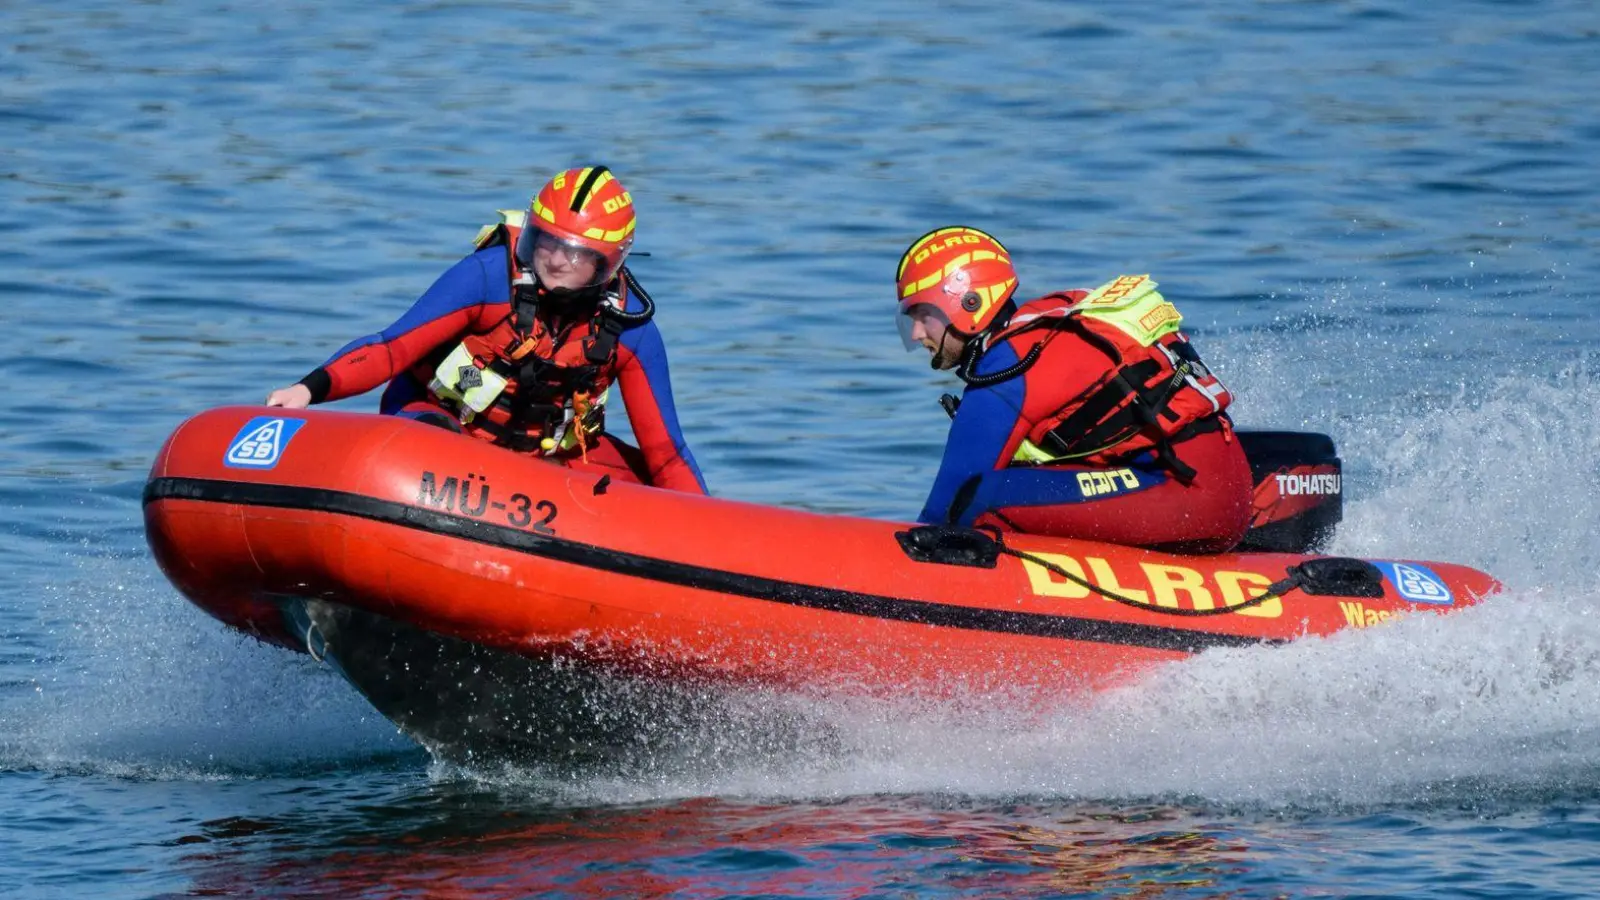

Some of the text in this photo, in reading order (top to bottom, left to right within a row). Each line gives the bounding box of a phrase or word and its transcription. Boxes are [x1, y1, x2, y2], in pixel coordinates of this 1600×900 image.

[914, 235, 980, 265] DLRG
[1076, 468, 1140, 497] DLRG
[1275, 474, 1341, 495] TOHATSU
[417, 471, 558, 536] MÜ-32
[1020, 551, 1283, 618] DLRG
